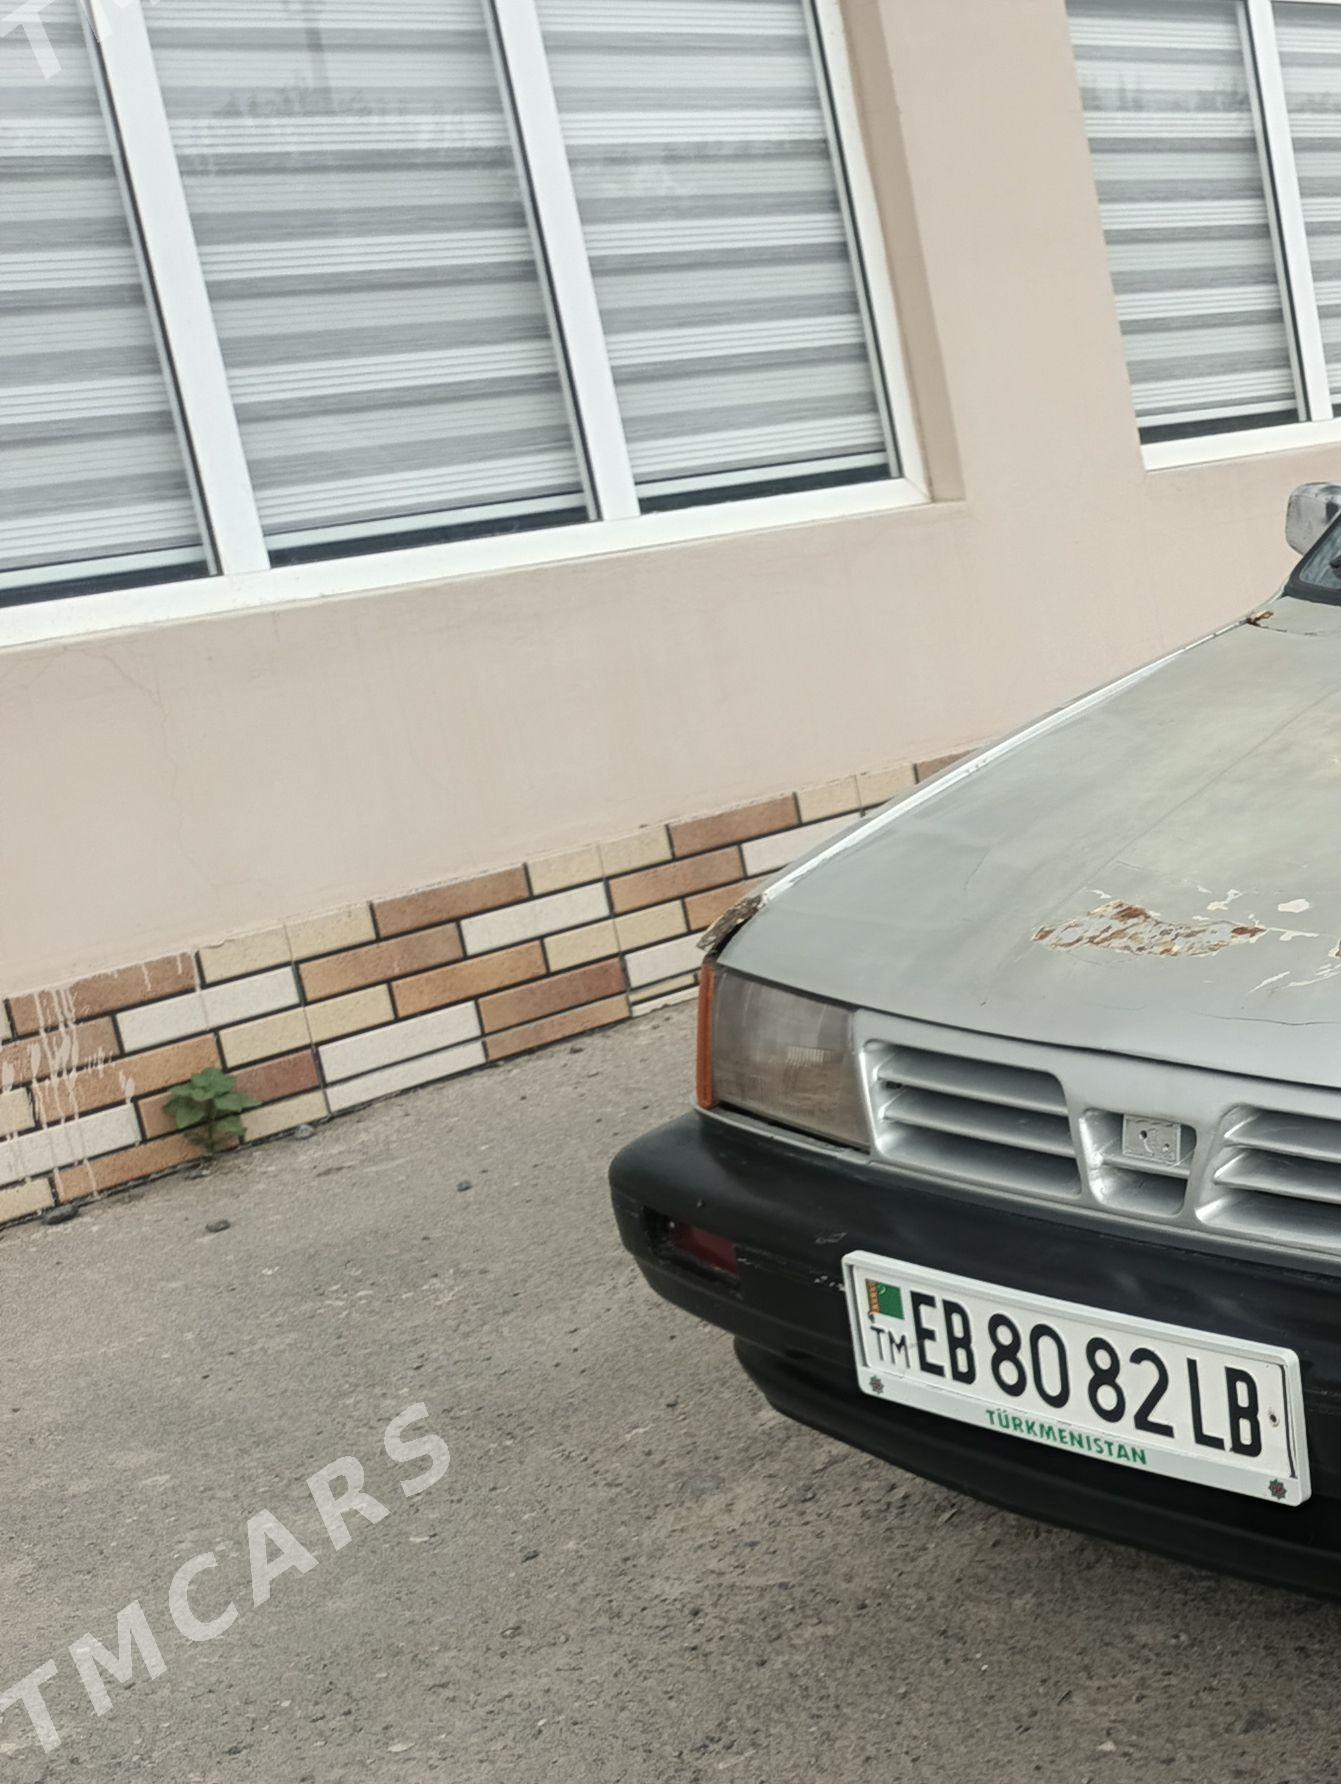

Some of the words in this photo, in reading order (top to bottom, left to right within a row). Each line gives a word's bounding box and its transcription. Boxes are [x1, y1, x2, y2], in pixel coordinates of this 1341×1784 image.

[870, 1325, 910, 1370] TM
[988, 1313, 1070, 1409] 80
[1086, 1337, 1174, 1438] 82
[986, 1408, 1148, 1465] TÜRKMENISTAN
